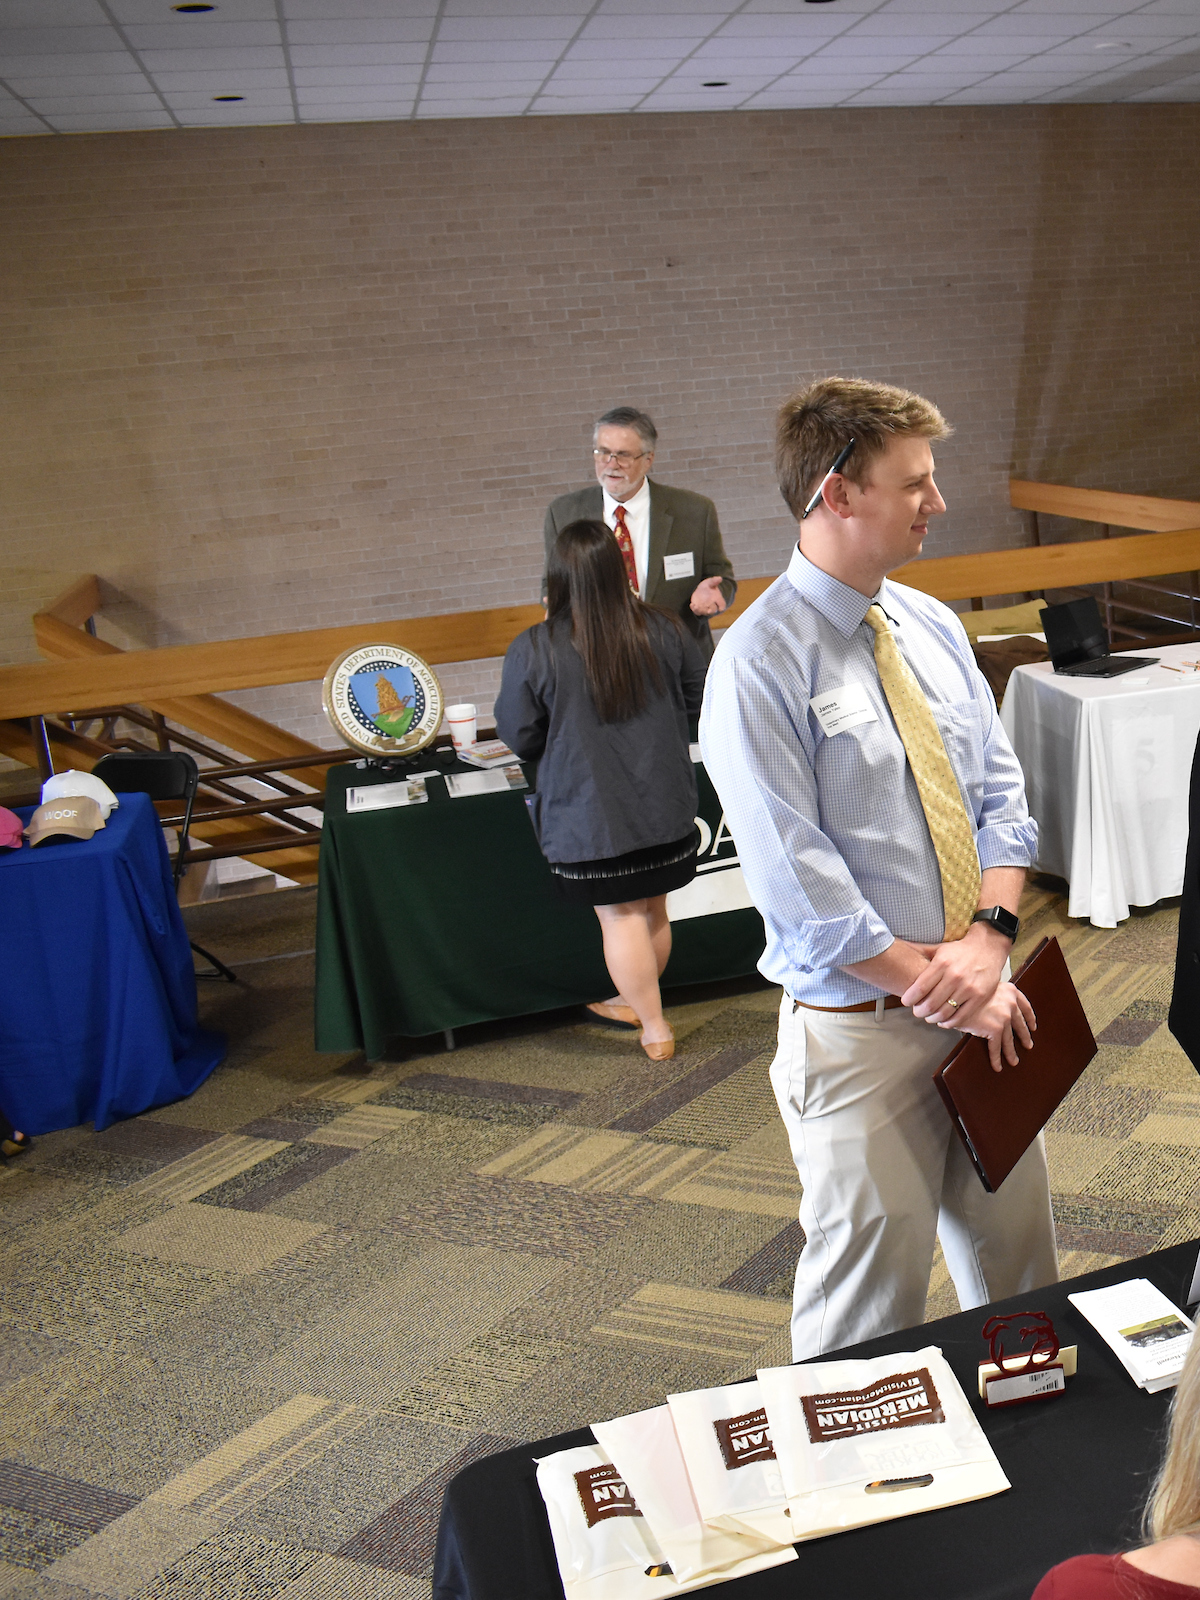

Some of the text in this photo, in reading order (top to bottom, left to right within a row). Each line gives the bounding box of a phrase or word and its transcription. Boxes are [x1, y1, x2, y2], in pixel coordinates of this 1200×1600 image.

[335, 648, 438, 743] UNITED STATES DEPARTMENT OF AGRICULTURE
[818, 701, 838, 713] James
[1134, 738, 1156, 777] 5
[44, 809, 78, 821] WOOF
[815, 1380, 909, 1405] VisitMeridian.com
[816, 1391, 930, 1428] MERIDIAN
[855, 1415, 899, 1432] VISIT
